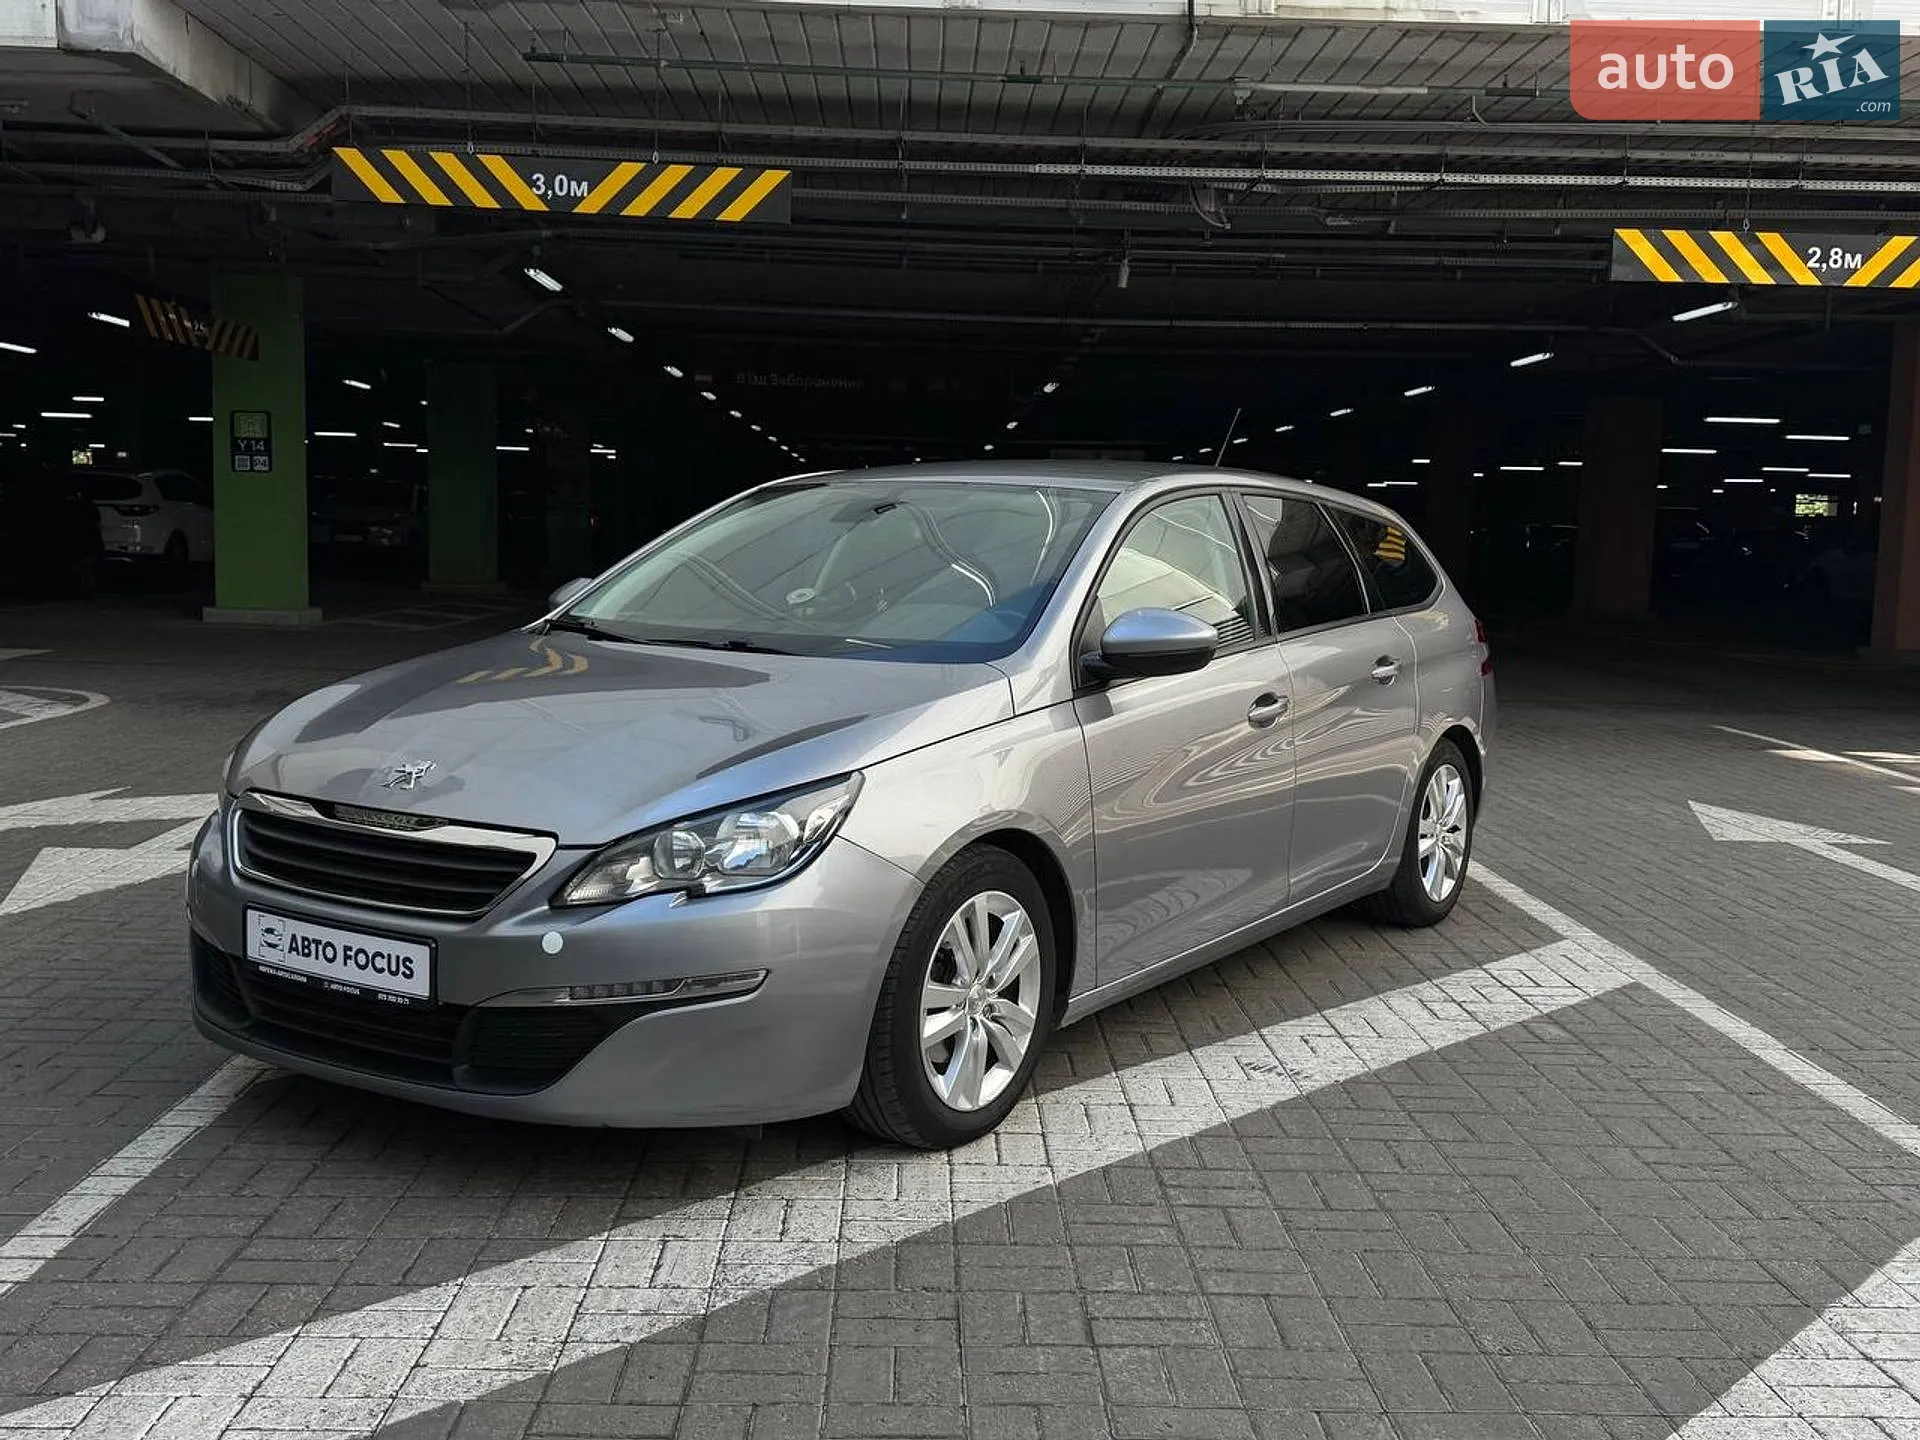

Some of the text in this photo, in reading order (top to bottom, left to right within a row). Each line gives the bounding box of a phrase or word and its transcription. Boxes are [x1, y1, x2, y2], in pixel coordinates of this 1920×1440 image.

[238, 440, 264, 451] Y 14
[288, 933, 337, 964] АВТО
[343, 944, 414, 980] FOCUS
